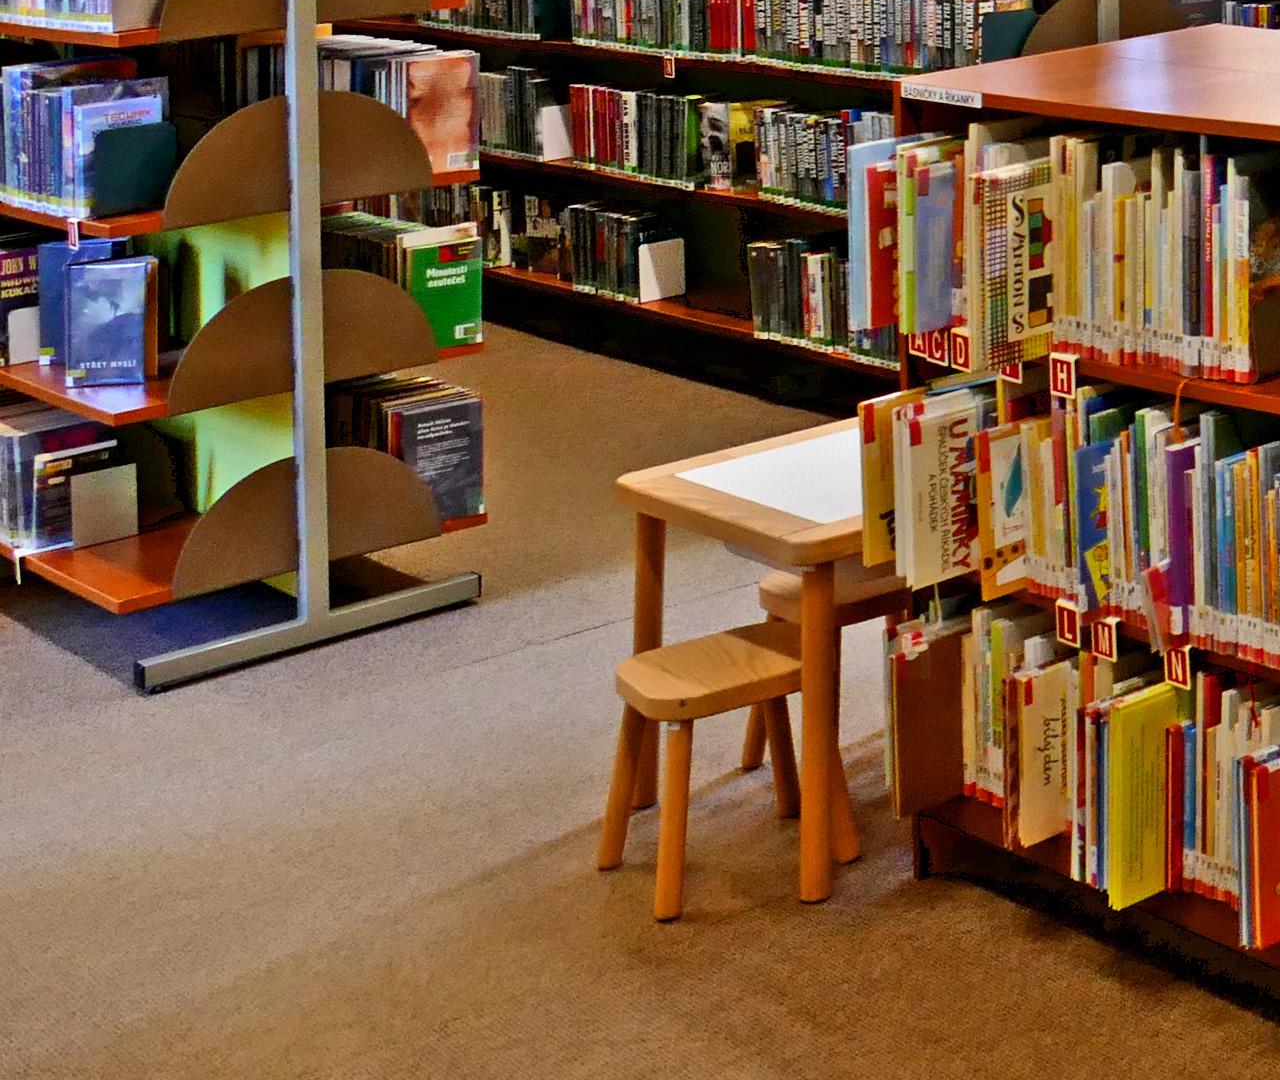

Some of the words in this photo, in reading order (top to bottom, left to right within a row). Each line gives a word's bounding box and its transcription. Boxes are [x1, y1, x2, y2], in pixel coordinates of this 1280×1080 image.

[904, 85, 937, 101] BÁSNIČKY
[938, 92, 943, 101] A
[946, 91, 975, 105] ŘÍKANKY
[932, 332, 942, 358] C
[957, 339, 966, 364] D
[1057, 362, 1068, 388] H
[949, 418, 969, 439] U
[937, 426, 950, 475] ŠPALÍČEK
[929, 474, 936, 482] A
[928, 484, 937, 533] POHÁDEK
[938, 478, 950, 528] ČESKÝCH
[949, 447, 971, 569] MAMINKY
[940, 529, 950, 573] ŘÍKADEL
[1063, 606, 1073, 640] L
[1098, 624, 1110, 655] M
[1173, 651, 1183, 679] N
[1043, 754, 1059, 786] den
